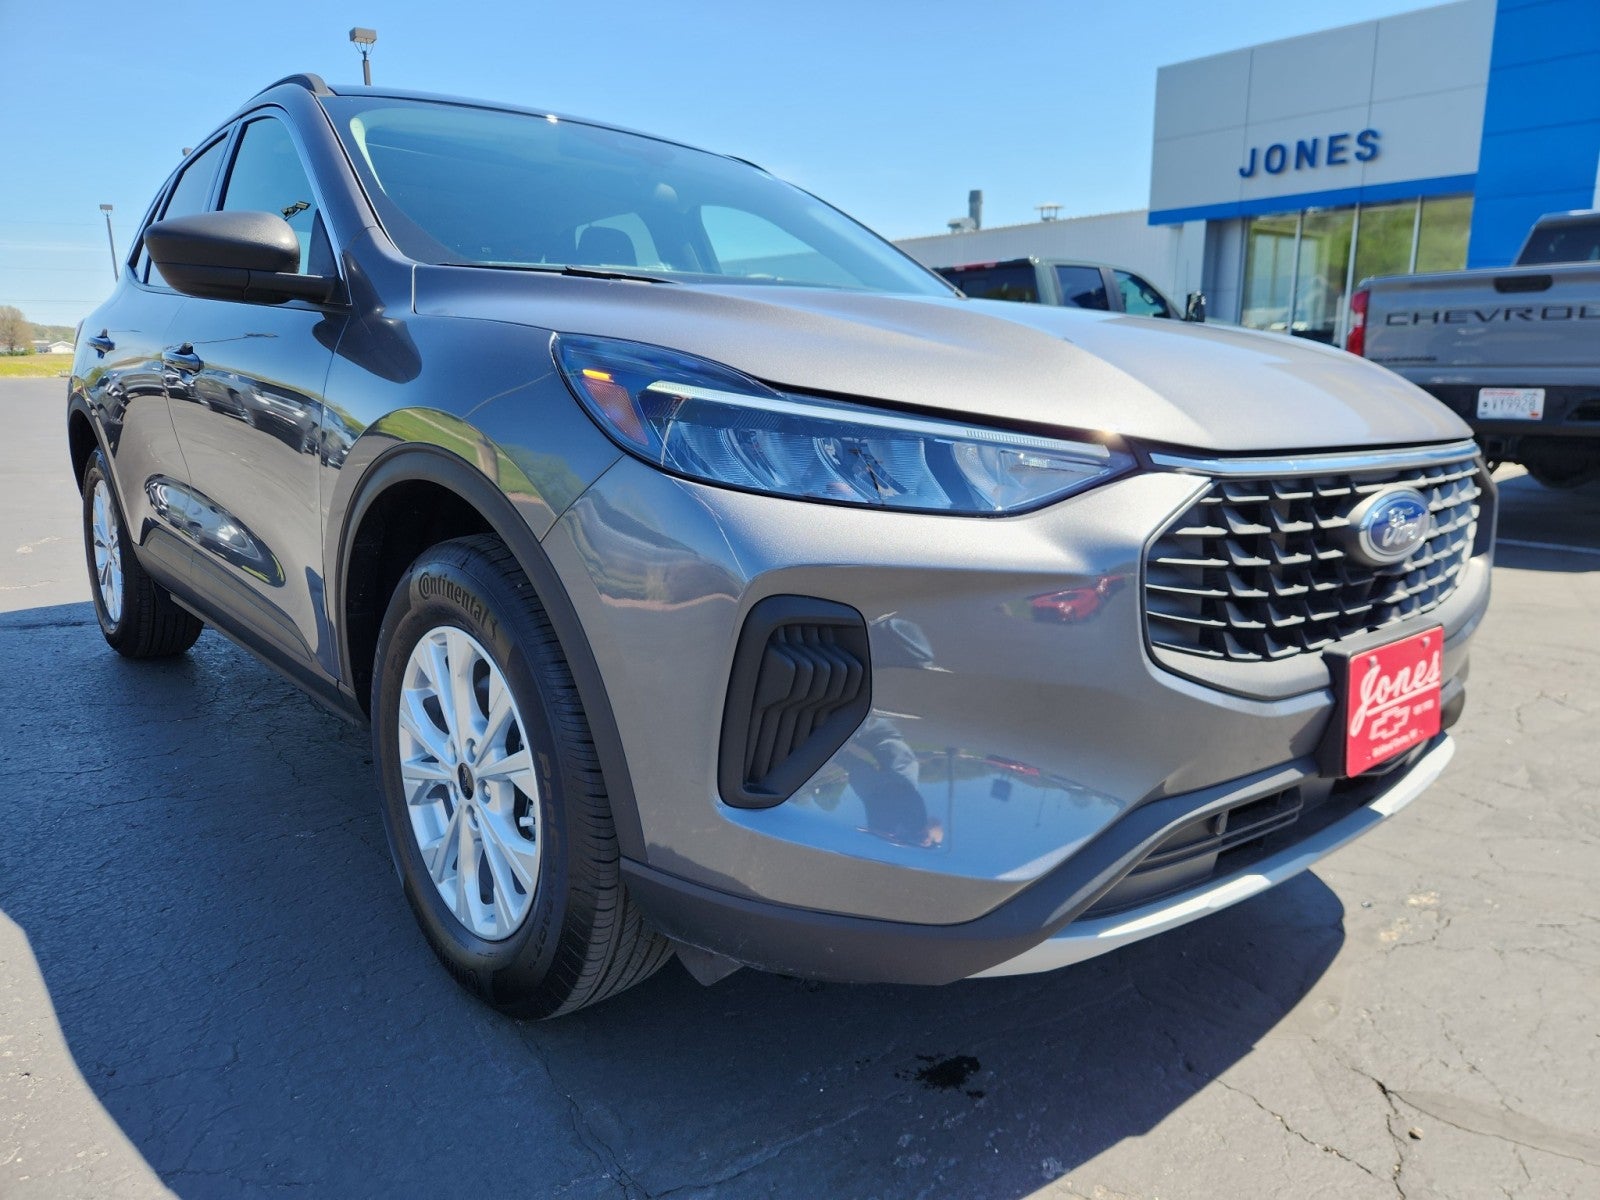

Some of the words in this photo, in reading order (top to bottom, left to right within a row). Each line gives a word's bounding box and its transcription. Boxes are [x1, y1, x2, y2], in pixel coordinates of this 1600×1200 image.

[1239, 128, 1382, 179] JONES
[418, 572, 490, 629] Continental
[1349, 650, 1441, 738] Jones
